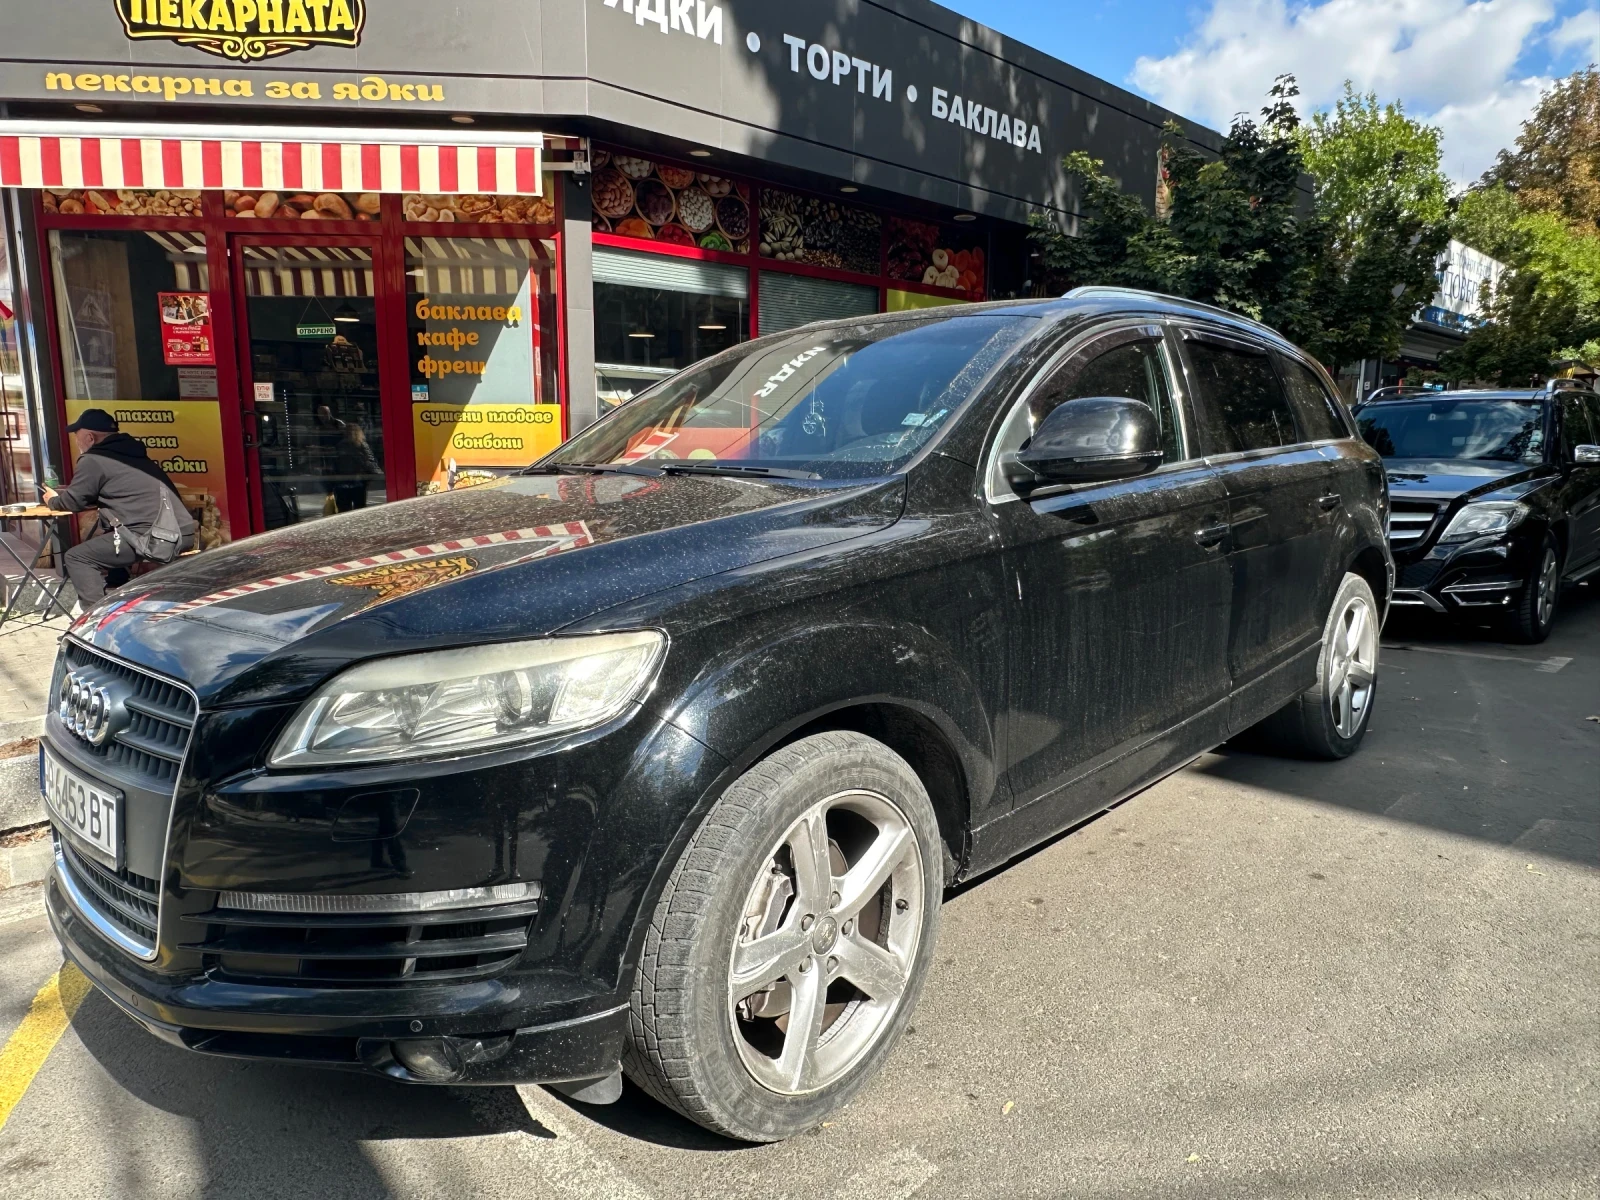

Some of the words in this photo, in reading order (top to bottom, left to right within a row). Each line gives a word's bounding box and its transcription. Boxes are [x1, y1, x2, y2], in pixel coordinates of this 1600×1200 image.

[130, 0, 355, 33] ПЕКАРНАТА
[45, 71, 254, 101] пекарна
[265, 81, 322, 100] за
[333, 77, 446, 103] ядки
[603, 0, 723, 46] ДКИ
[783, 33, 893, 103] ТОРТИ
[931, 86, 1042, 155] БАКЛАВА
[415, 298, 522, 321] баклава
[299, 327, 334, 335] ОТВОРЕНО
[417, 327, 479, 351] кафе
[417, 355, 487, 379] фреш
[421, 410, 483, 426] сушени
[487, 408, 553, 423] плодове
[453, 433, 523, 449] бонбони
[161, 455, 208, 473] ядки
[55, 767, 86, 831] 6453
[90, 791, 115, 848] BT
